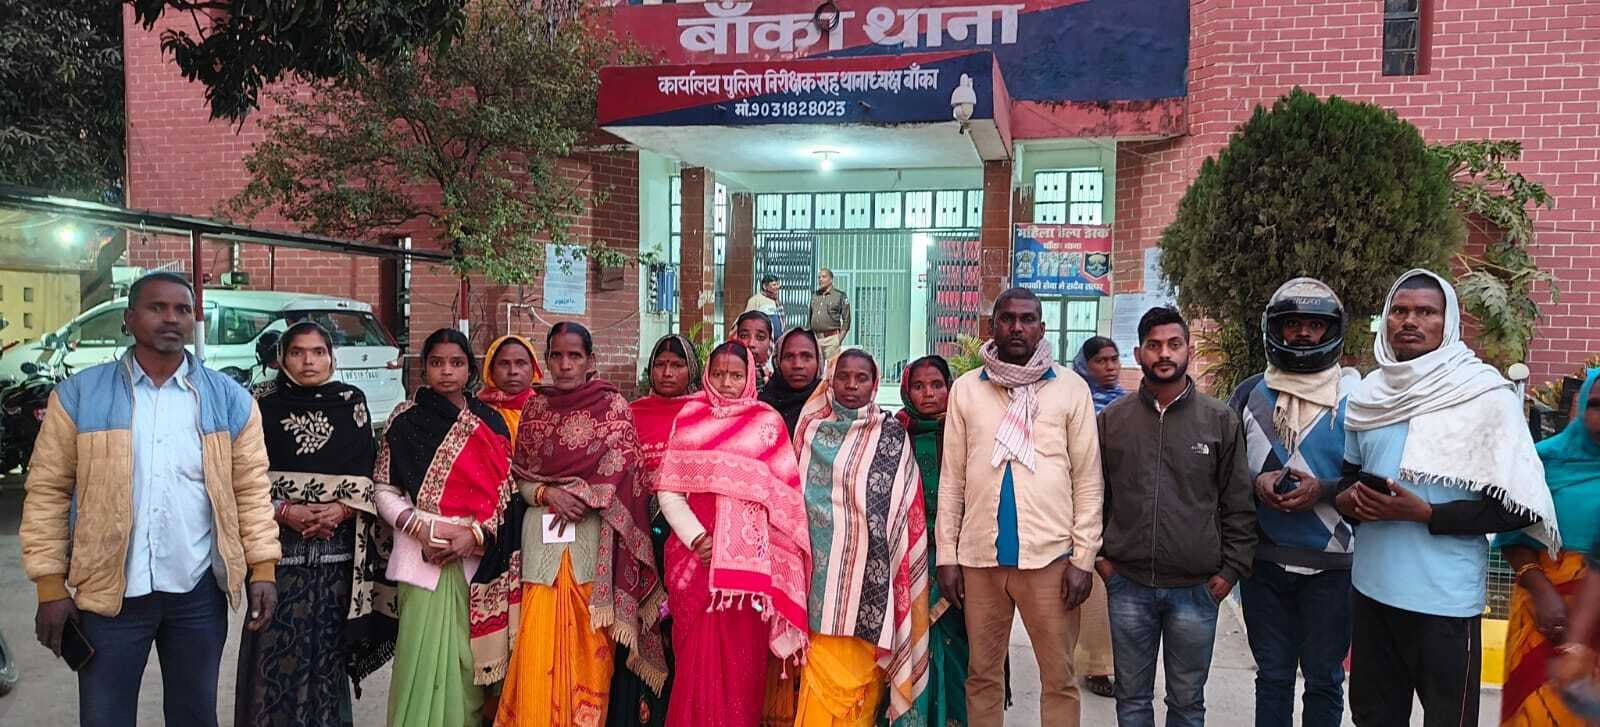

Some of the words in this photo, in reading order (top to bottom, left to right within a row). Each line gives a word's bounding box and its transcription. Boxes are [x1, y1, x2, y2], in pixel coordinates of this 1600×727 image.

[678, 2, 855, 54] बाँका
[863, 3, 1025, 48] थाना
[658, 70, 721, 96] कार्यालय
[722, 69, 763, 99] पुलिस
[840, 70, 901, 94] थानाध्यक्ष
[903, 62, 939, 90] बाँका
